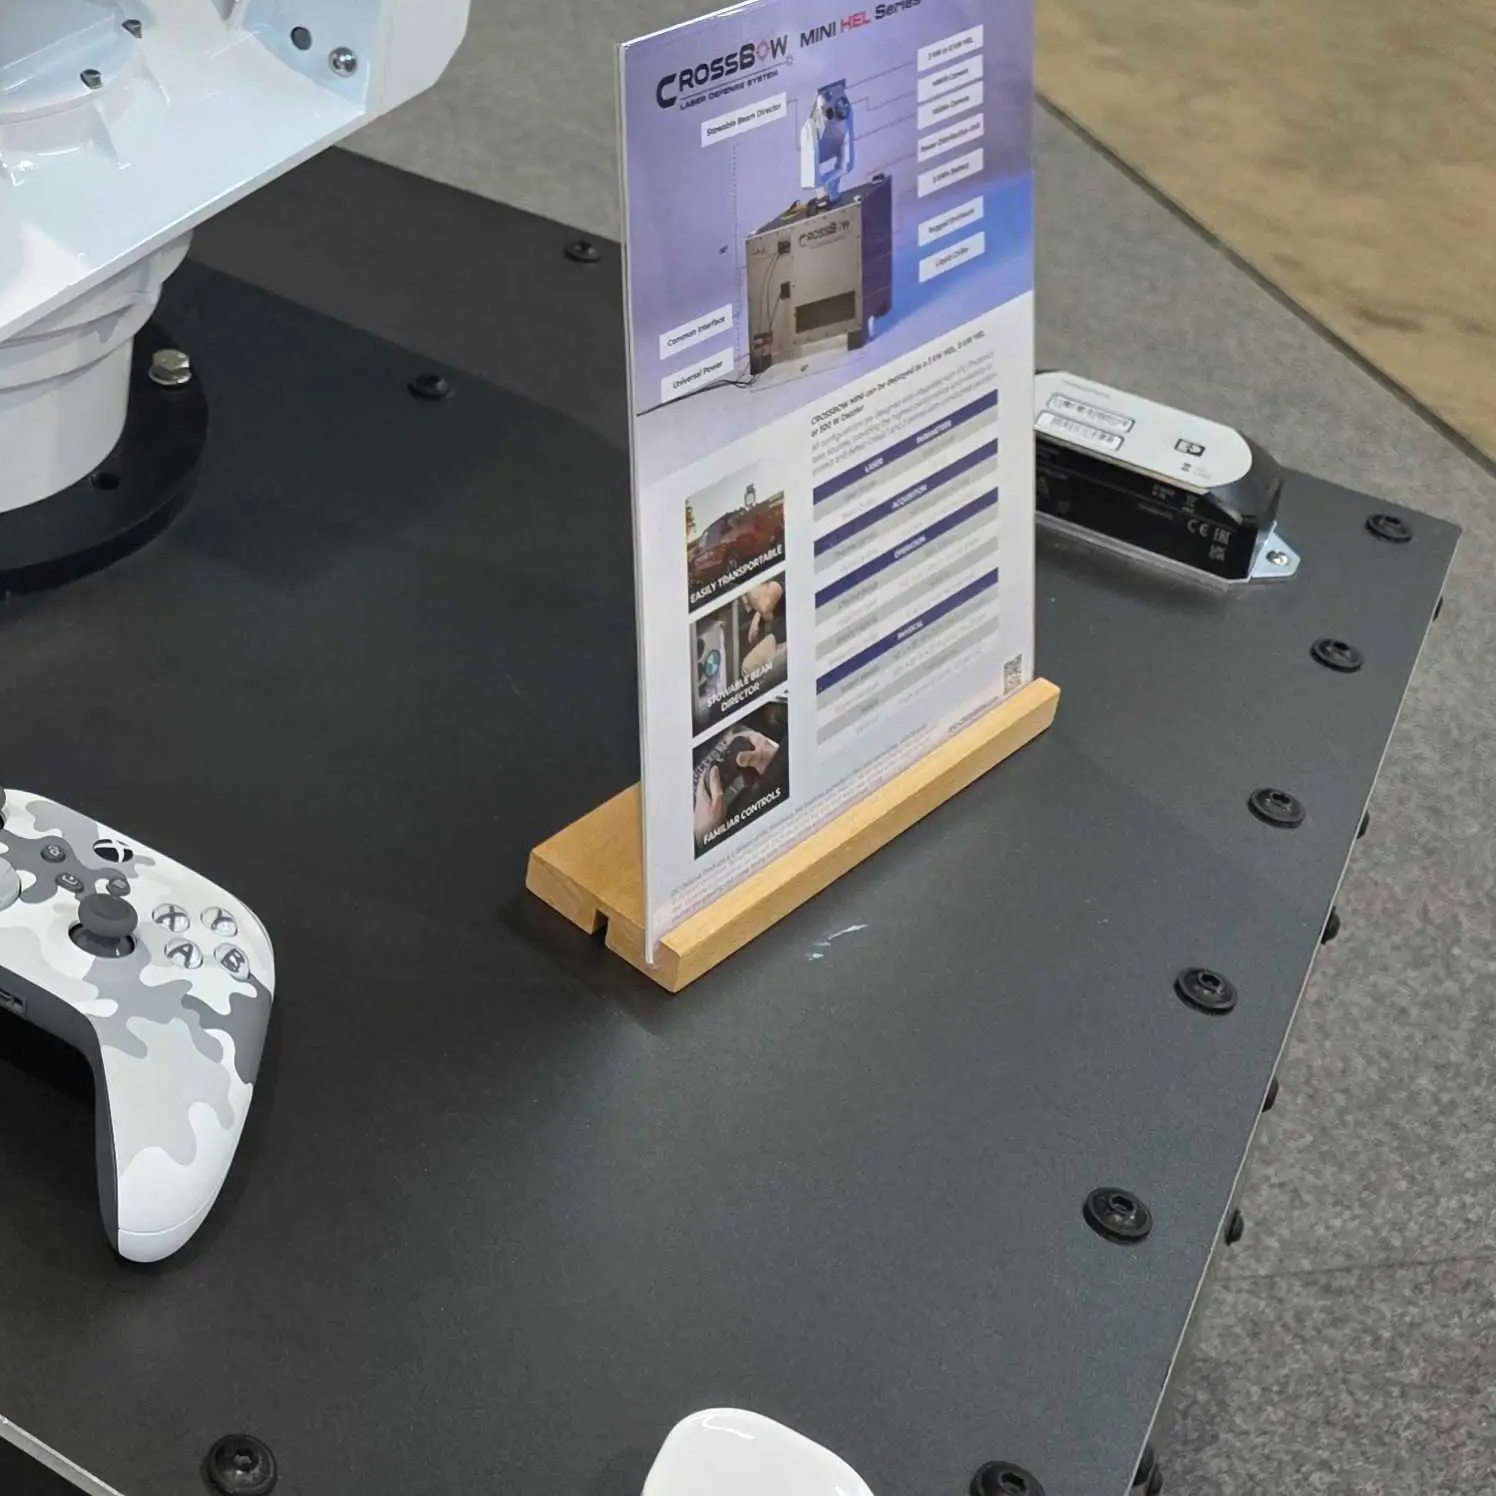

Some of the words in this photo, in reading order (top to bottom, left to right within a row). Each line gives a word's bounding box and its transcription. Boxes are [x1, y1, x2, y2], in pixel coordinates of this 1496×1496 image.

[800, 21, 837, 48] MINI
[839, 10, 871, 33] HEL
[690, 583, 717, 604] EASILY
[717, 543, 783, 591] TRANSPORTABLE
[720, 682, 761, 713] DIRECTOR
[702, 812, 740, 845] FAMILIAR
[739, 786, 782, 821] CONTROLS
[168, 942, 195, 968] A
[219, 947, 246, 973] B
